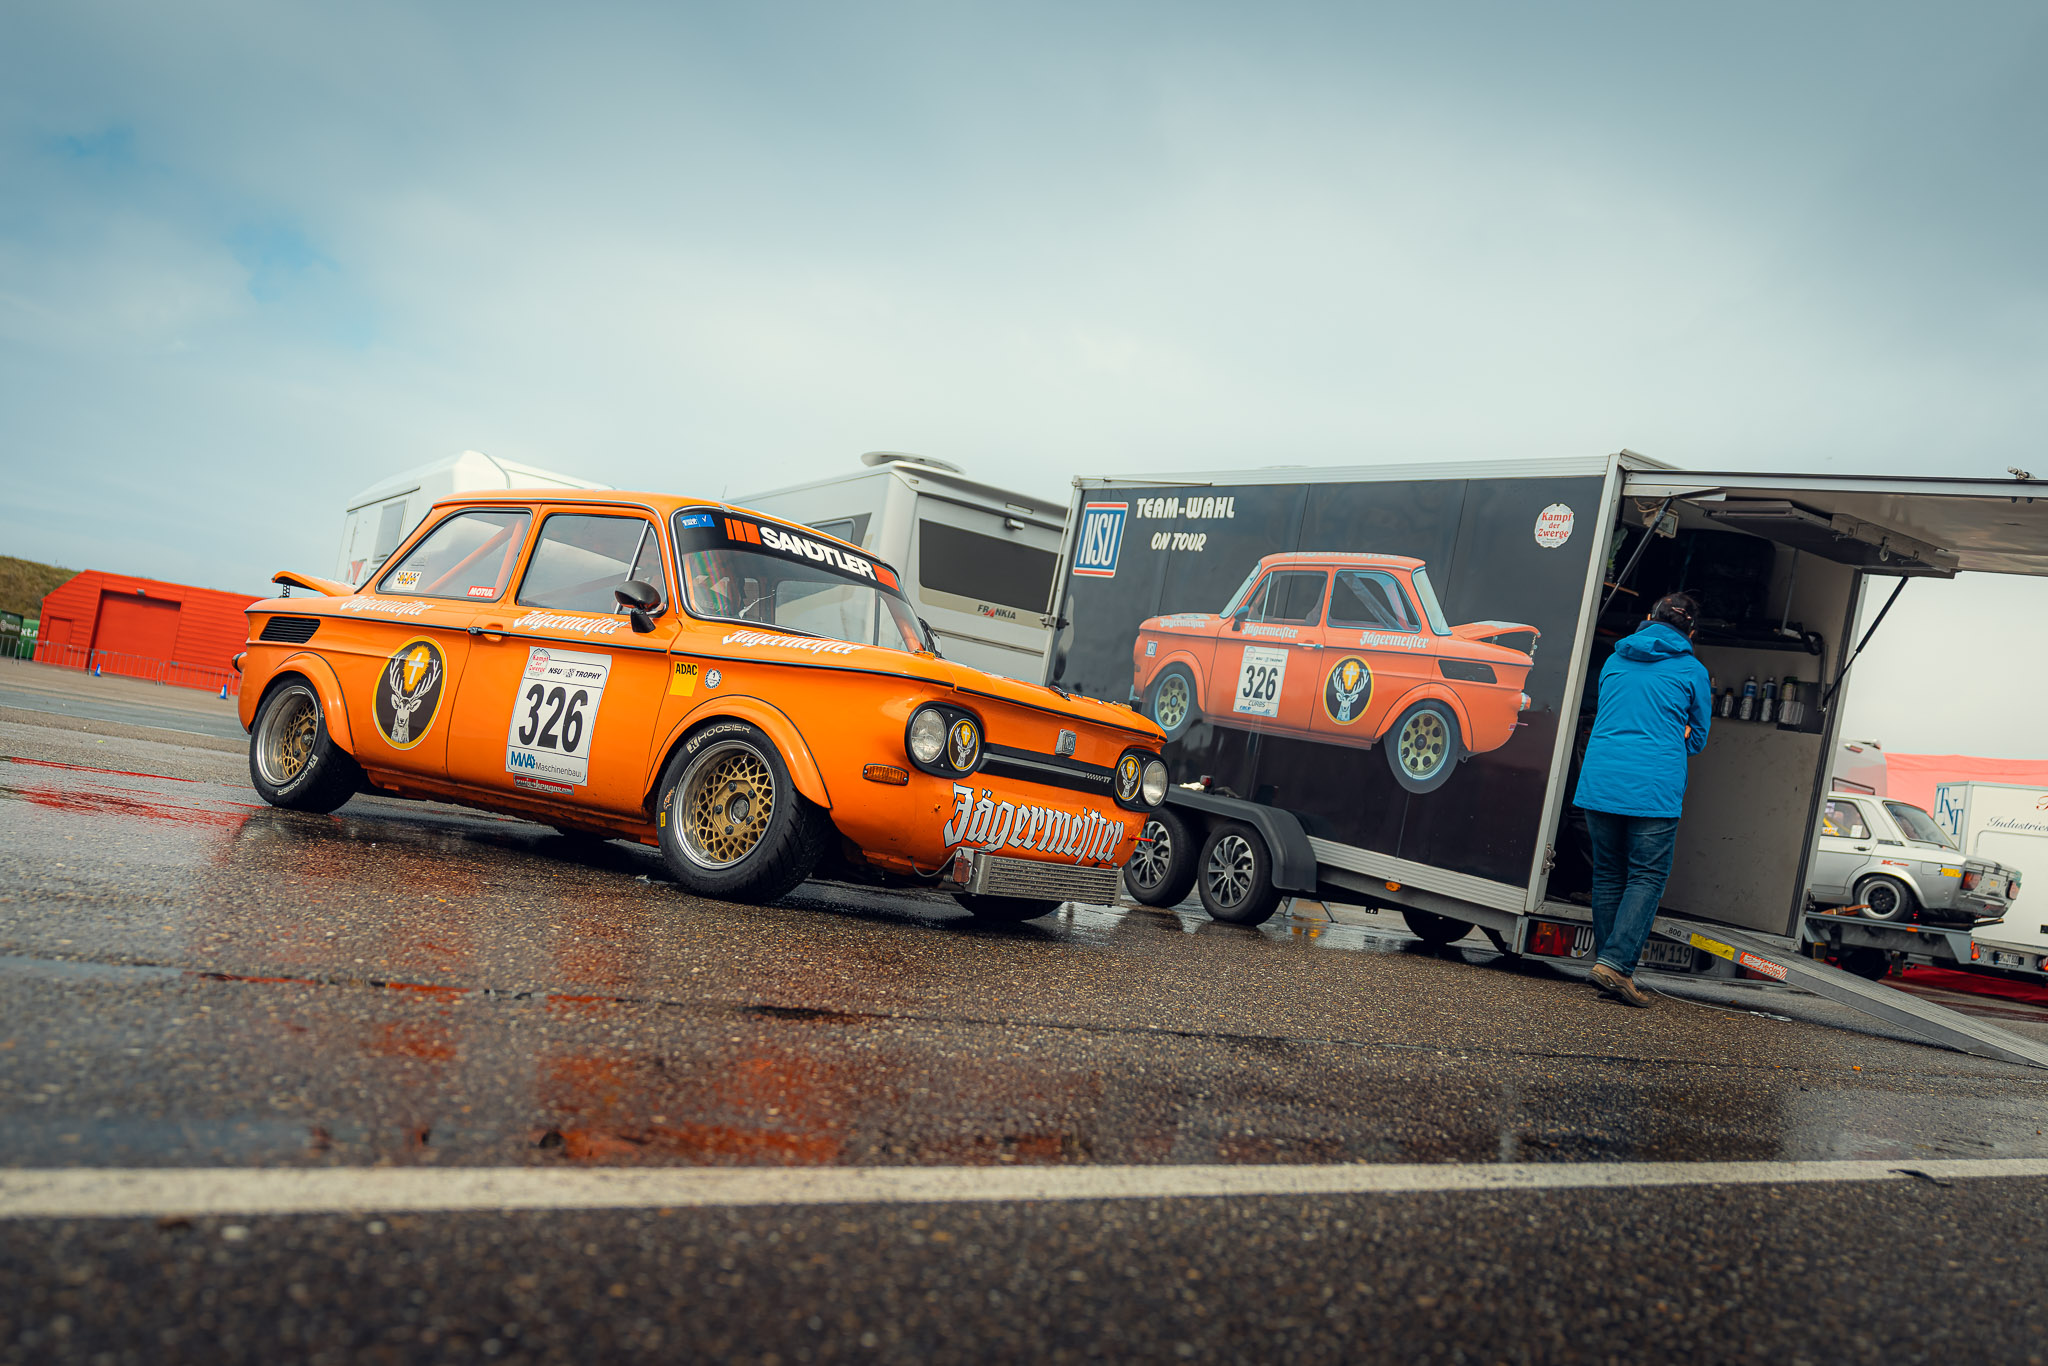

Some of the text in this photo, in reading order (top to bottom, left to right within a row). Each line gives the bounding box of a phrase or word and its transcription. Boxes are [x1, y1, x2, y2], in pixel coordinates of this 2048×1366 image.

[1136, 497, 1235, 519] TEAM-WAHL
[1541, 511, 1573, 523] Kampf
[1079, 513, 1121, 567] NSU
[1151, 532, 1207, 552] ON TOUR
[1537, 528, 1569, 539] Zwerge
[759, 526, 878, 581] SANDTLER
[468, 586, 495, 597] MOTUL
[339, 595, 436, 617] Jägermeister
[977, 604, 1017, 620] FRANKIA
[513, 610, 629, 636] Jägermeister
[1241, 623, 1299, 640] Jägermeister
[722, 629, 866, 655] Jägermeister
[1359, 631, 1430, 650] Jägermeister
[548, 667, 602, 680] NSU TROPHY
[675, 663, 698, 676] ADAC
[1242, 665, 1278, 701] 326
[518, 683, 588, 753] 326
[697, 724, 752, 743] HOOSIER
[535, 762, 580, 778] Maschinenbau
[1937, 787, 1964, 835] TNT
[943, 782, 1124, 865] Jägermeister
[1669, 927, 1681, 937] 800
[1649, 942, 1691, 964] MW 119
